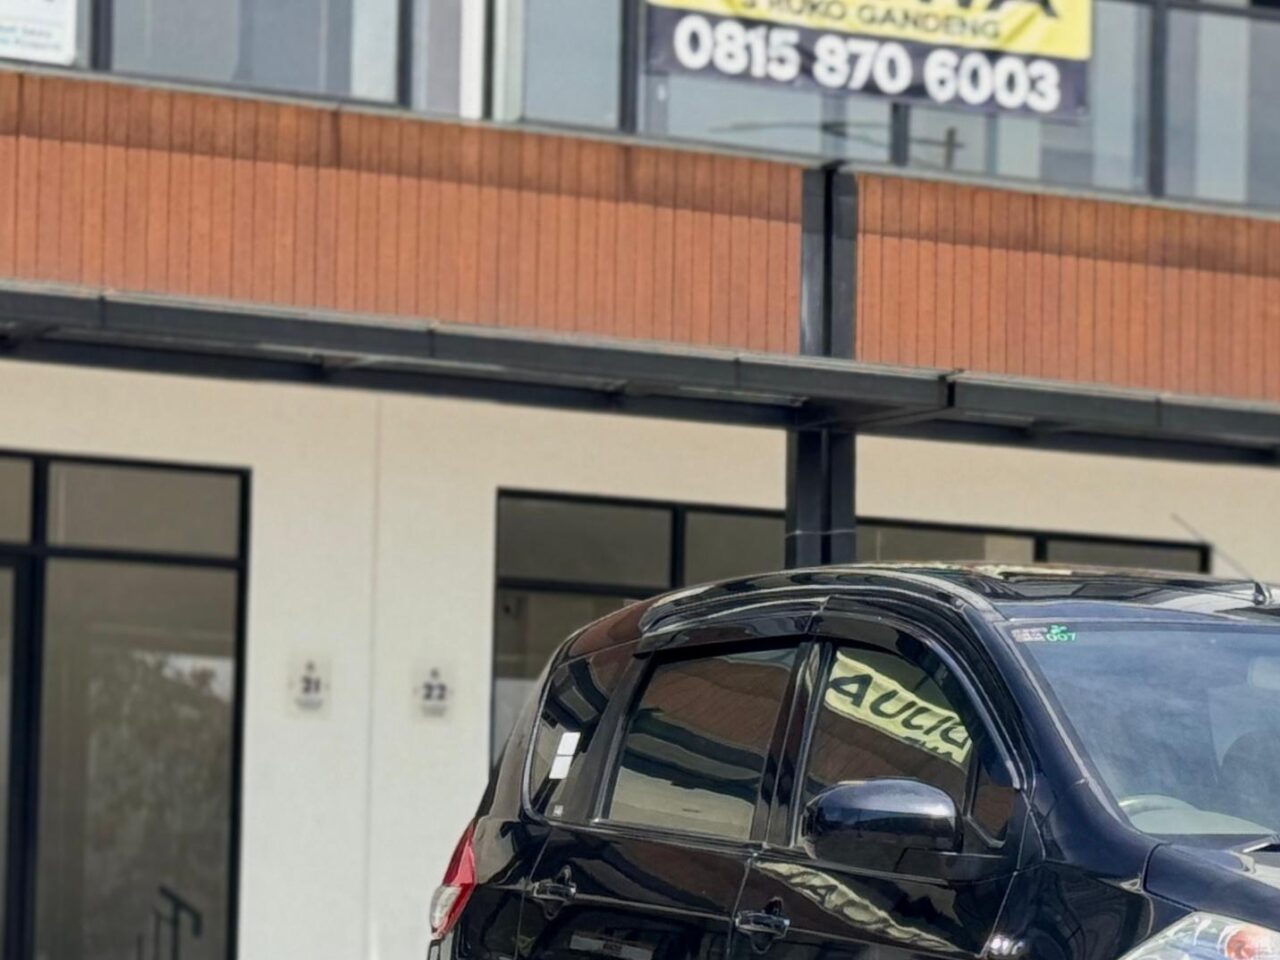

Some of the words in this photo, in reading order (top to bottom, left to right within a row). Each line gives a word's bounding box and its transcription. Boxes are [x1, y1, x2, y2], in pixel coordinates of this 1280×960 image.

[857, 4, 1000, 39] GANDENG
[673, 14, 800, 80] 0815
[812, 33, 912, 94] 870
[924, 48, 1061, 113] 6003
